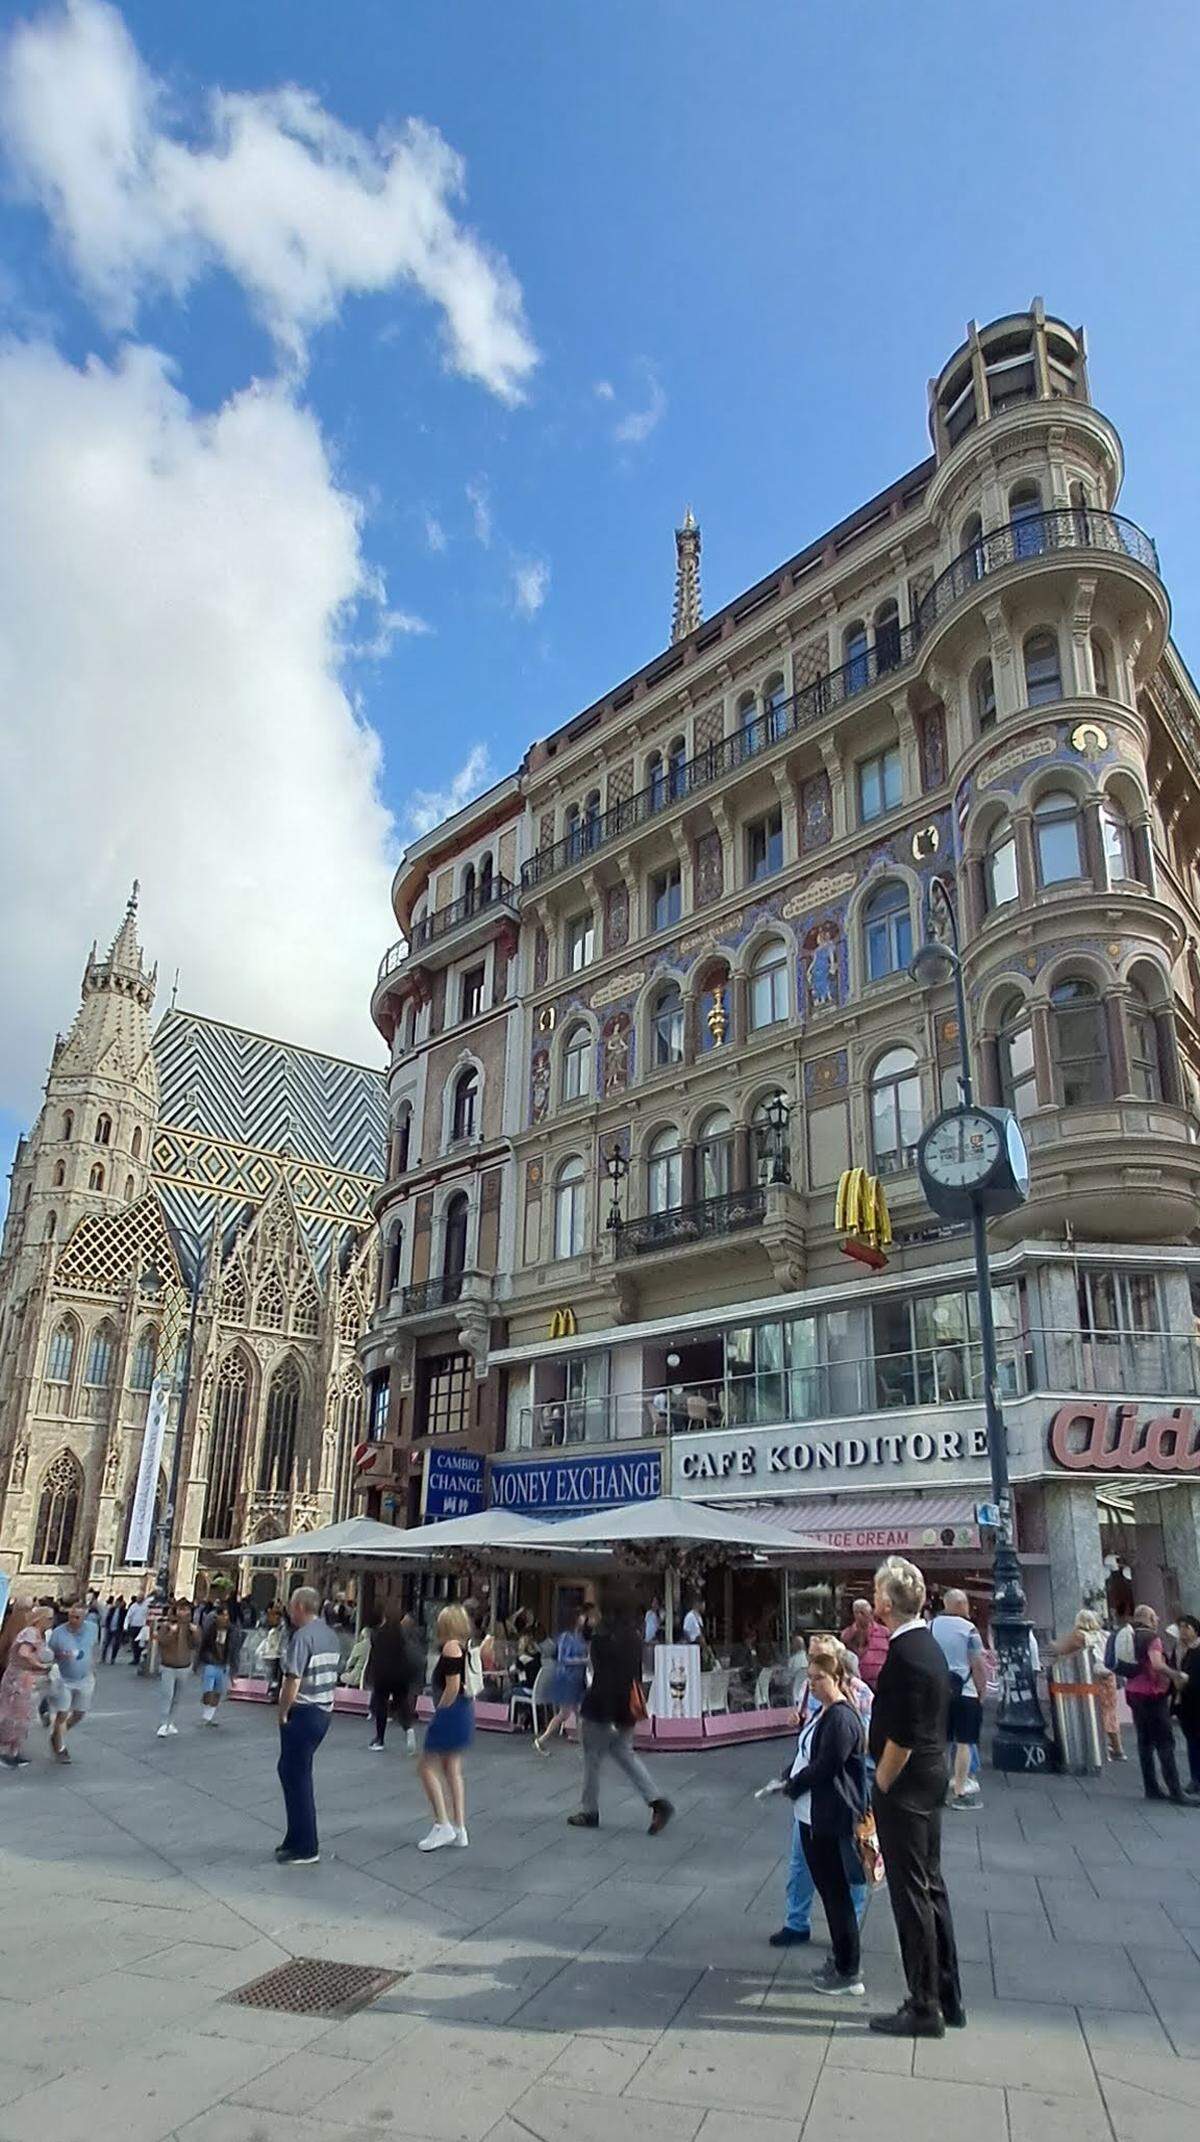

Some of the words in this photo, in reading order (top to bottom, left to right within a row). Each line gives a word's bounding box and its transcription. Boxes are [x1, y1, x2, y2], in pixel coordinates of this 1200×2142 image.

[767, 1427, 1003, 1472] KONDITORE
[437, 1454, 480, 1472] CAMBIO
[430, 1473, 484, 1494] CHANGE
[491, 1470, 552, 1505] MONEY
[556, 1461, 661, 1501] EXCHANGE
[828, 1533, 852, 1547] ICE
[856, 1531, 909, 1546] CREAM
